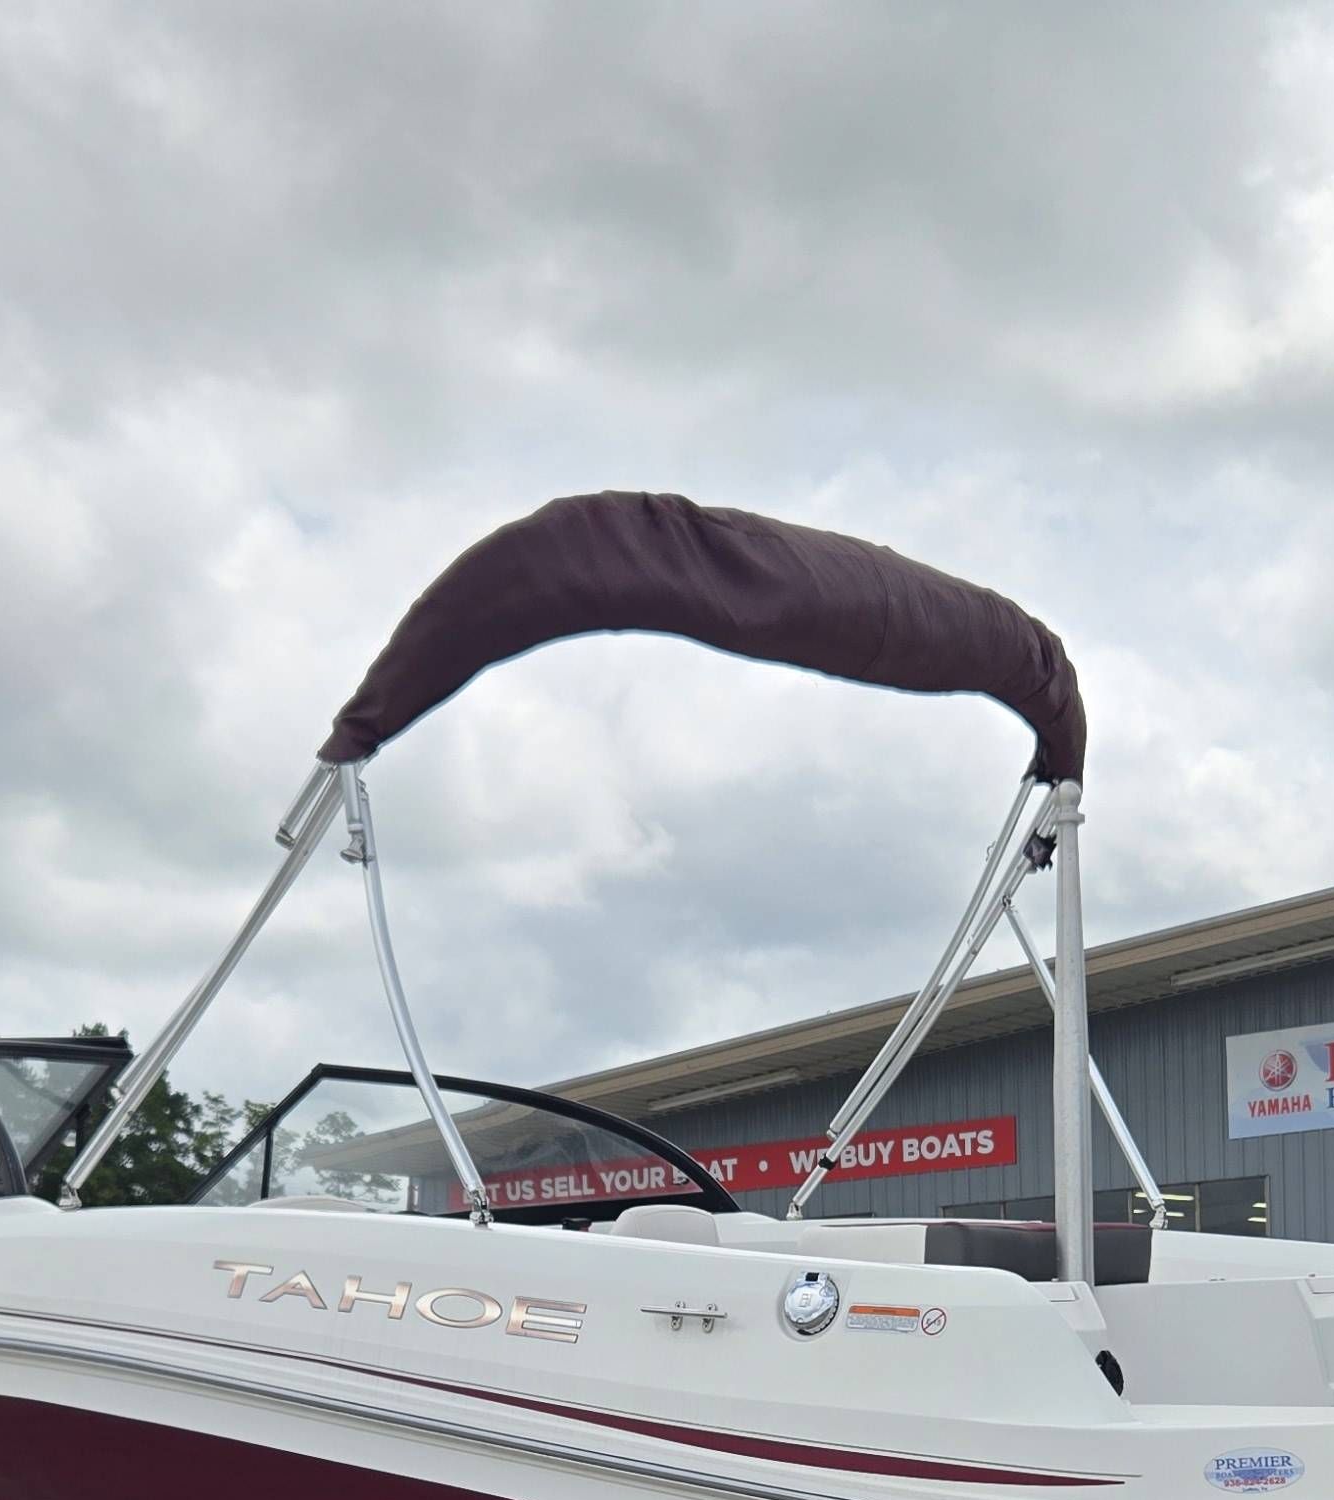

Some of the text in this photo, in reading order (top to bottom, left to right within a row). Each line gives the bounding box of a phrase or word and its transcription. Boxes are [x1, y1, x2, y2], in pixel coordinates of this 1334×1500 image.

[1247, 1094, 1312, 1118] YAMAHA
[506, 1179, 535, 1201] US
[540, 1174, 595, 1199] SELL
[599, 1166, 666, 1193] YOUR
[672, 1158, 738, 1185] BAT
[840, 1140, 895, 1169] BUY
[902, 1129, 995, 1162] BOATS
[212, 1259, 588, 1344] TAHOE
[1214, 1455, 1292, 1470] PREMIER
